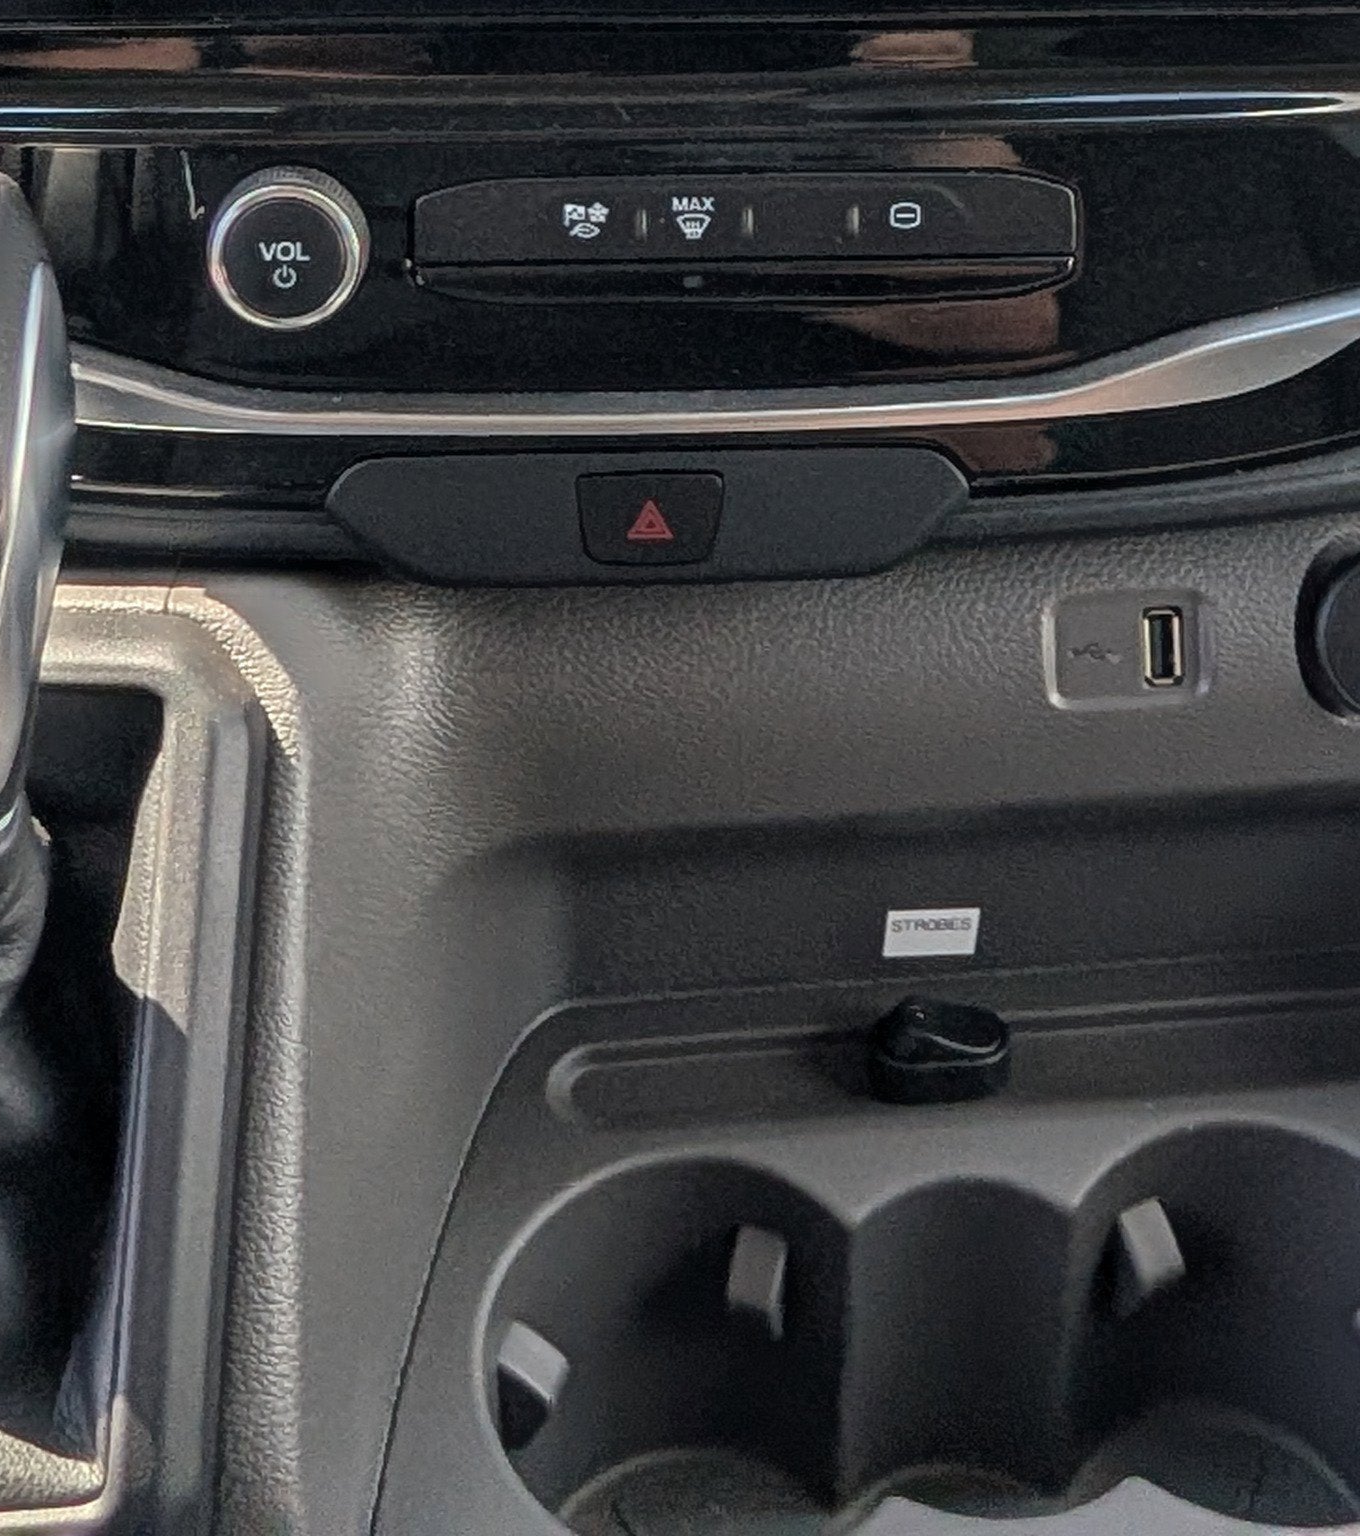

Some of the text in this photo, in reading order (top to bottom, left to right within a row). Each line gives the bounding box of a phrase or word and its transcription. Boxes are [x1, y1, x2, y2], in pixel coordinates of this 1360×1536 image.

[671, 196, 716, 213] MAX
[258, 241, 310, 263] VOL
[891, 916, 972, 933] STROBES
